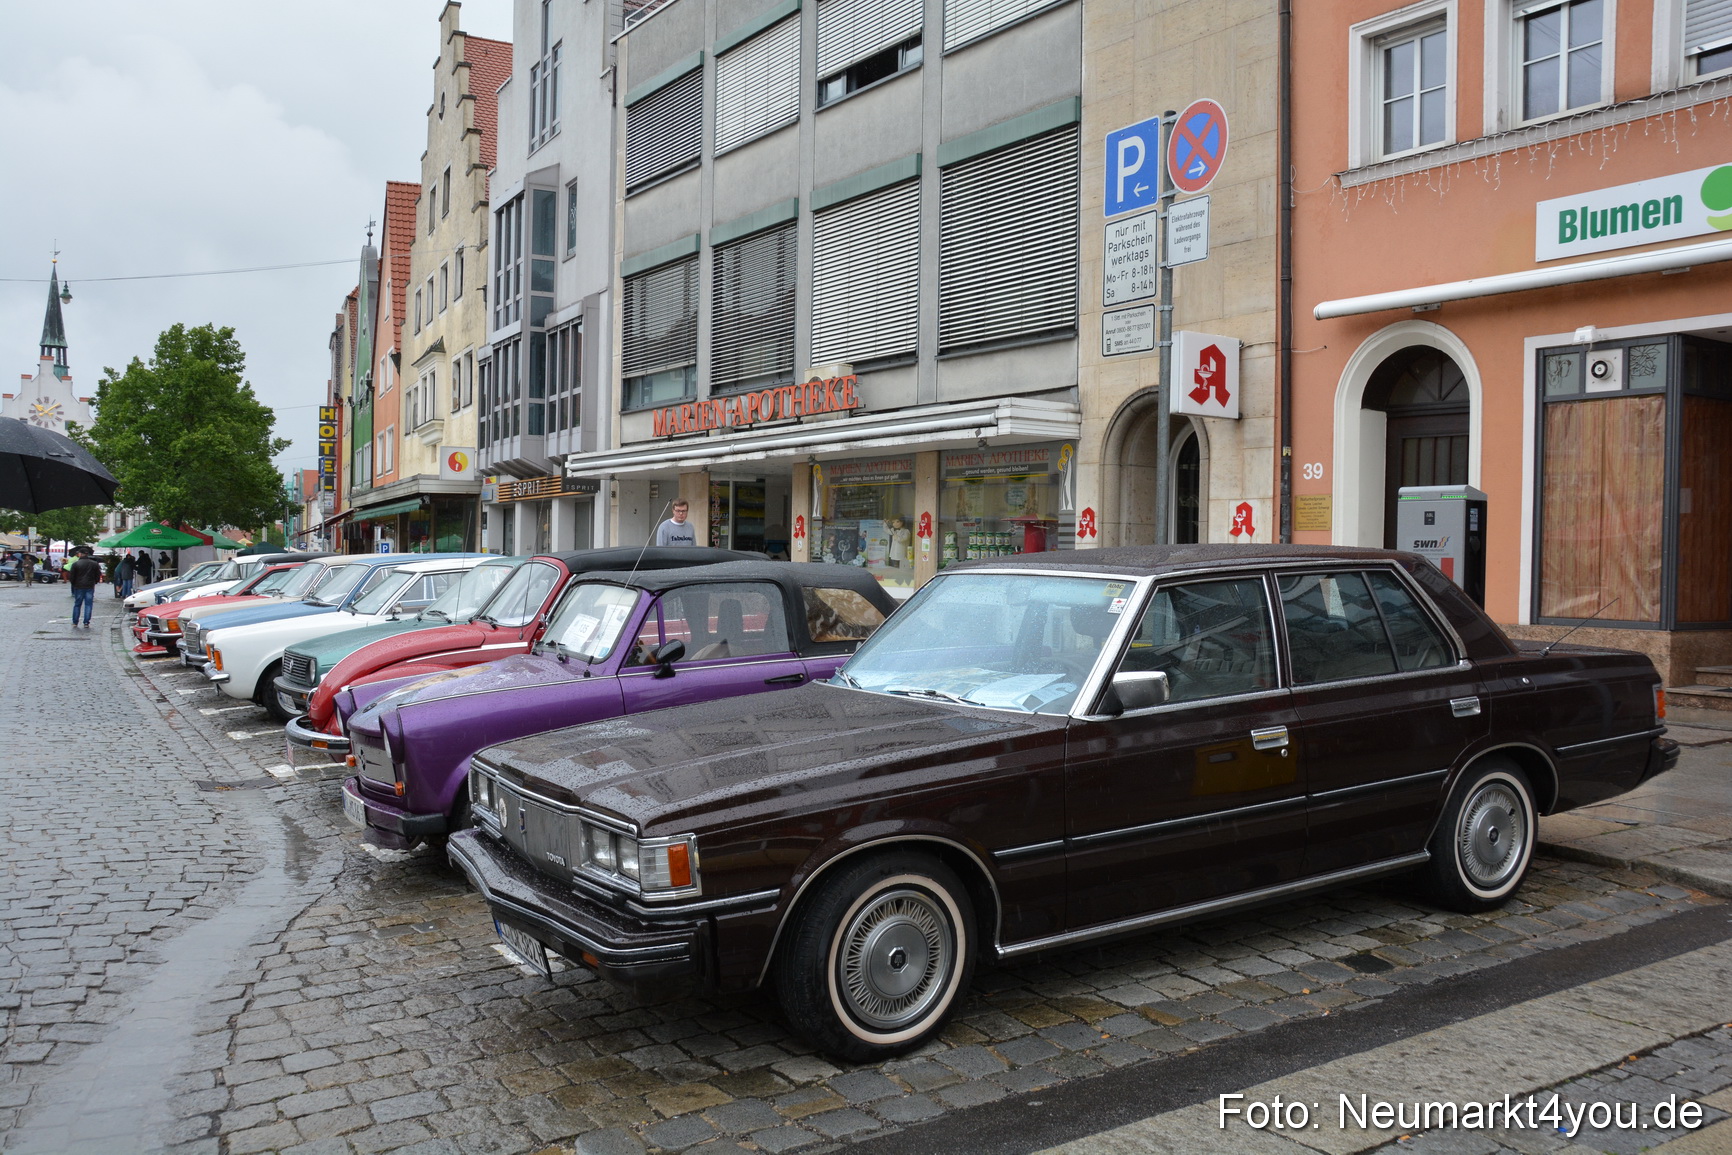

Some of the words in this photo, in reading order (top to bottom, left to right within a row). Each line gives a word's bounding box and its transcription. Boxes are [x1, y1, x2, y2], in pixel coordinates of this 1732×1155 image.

[1117, 135, 1146, 203] P
[1171, 209, 1206, 223] Elektrofahrzeuge
[1558, 194, 1683, 245] Blumen
[1115, 226, 1129, 238] nur
[1133, 219, 1146, 233] mit
[1175, 222, 1193, 232] während
[1193, 220, 1201, 229] des
[1108, 232, 1153, 253] Parkschein
[1174, 232, 1202, 245] Ladevorgangs
[1111, 249, 1149, 266] werktags
[1106, 270, 1129, 284] Mo-Fr
[1106, 288, 1115, 299] Sa
[652, 374, 859, 438] MARIEN-APOTHEKE
[320, 408, 334, 489] HOTE
[945, 453, 985, 467] MARIEN
[989, 448, 1050, 465] APOTHEKE
[830, 463, 862, 475] MARIEN
[865, 459, 913, 473] APOTHEKE
[997, 466, 1011, 474] gesund
[1303, 462, 1323, 480] 39
[513, 480, 540, 497] ESPRIT
[1413, 539, 1438, 548] swn
[546, 851, 566, 867] TOYOTA
